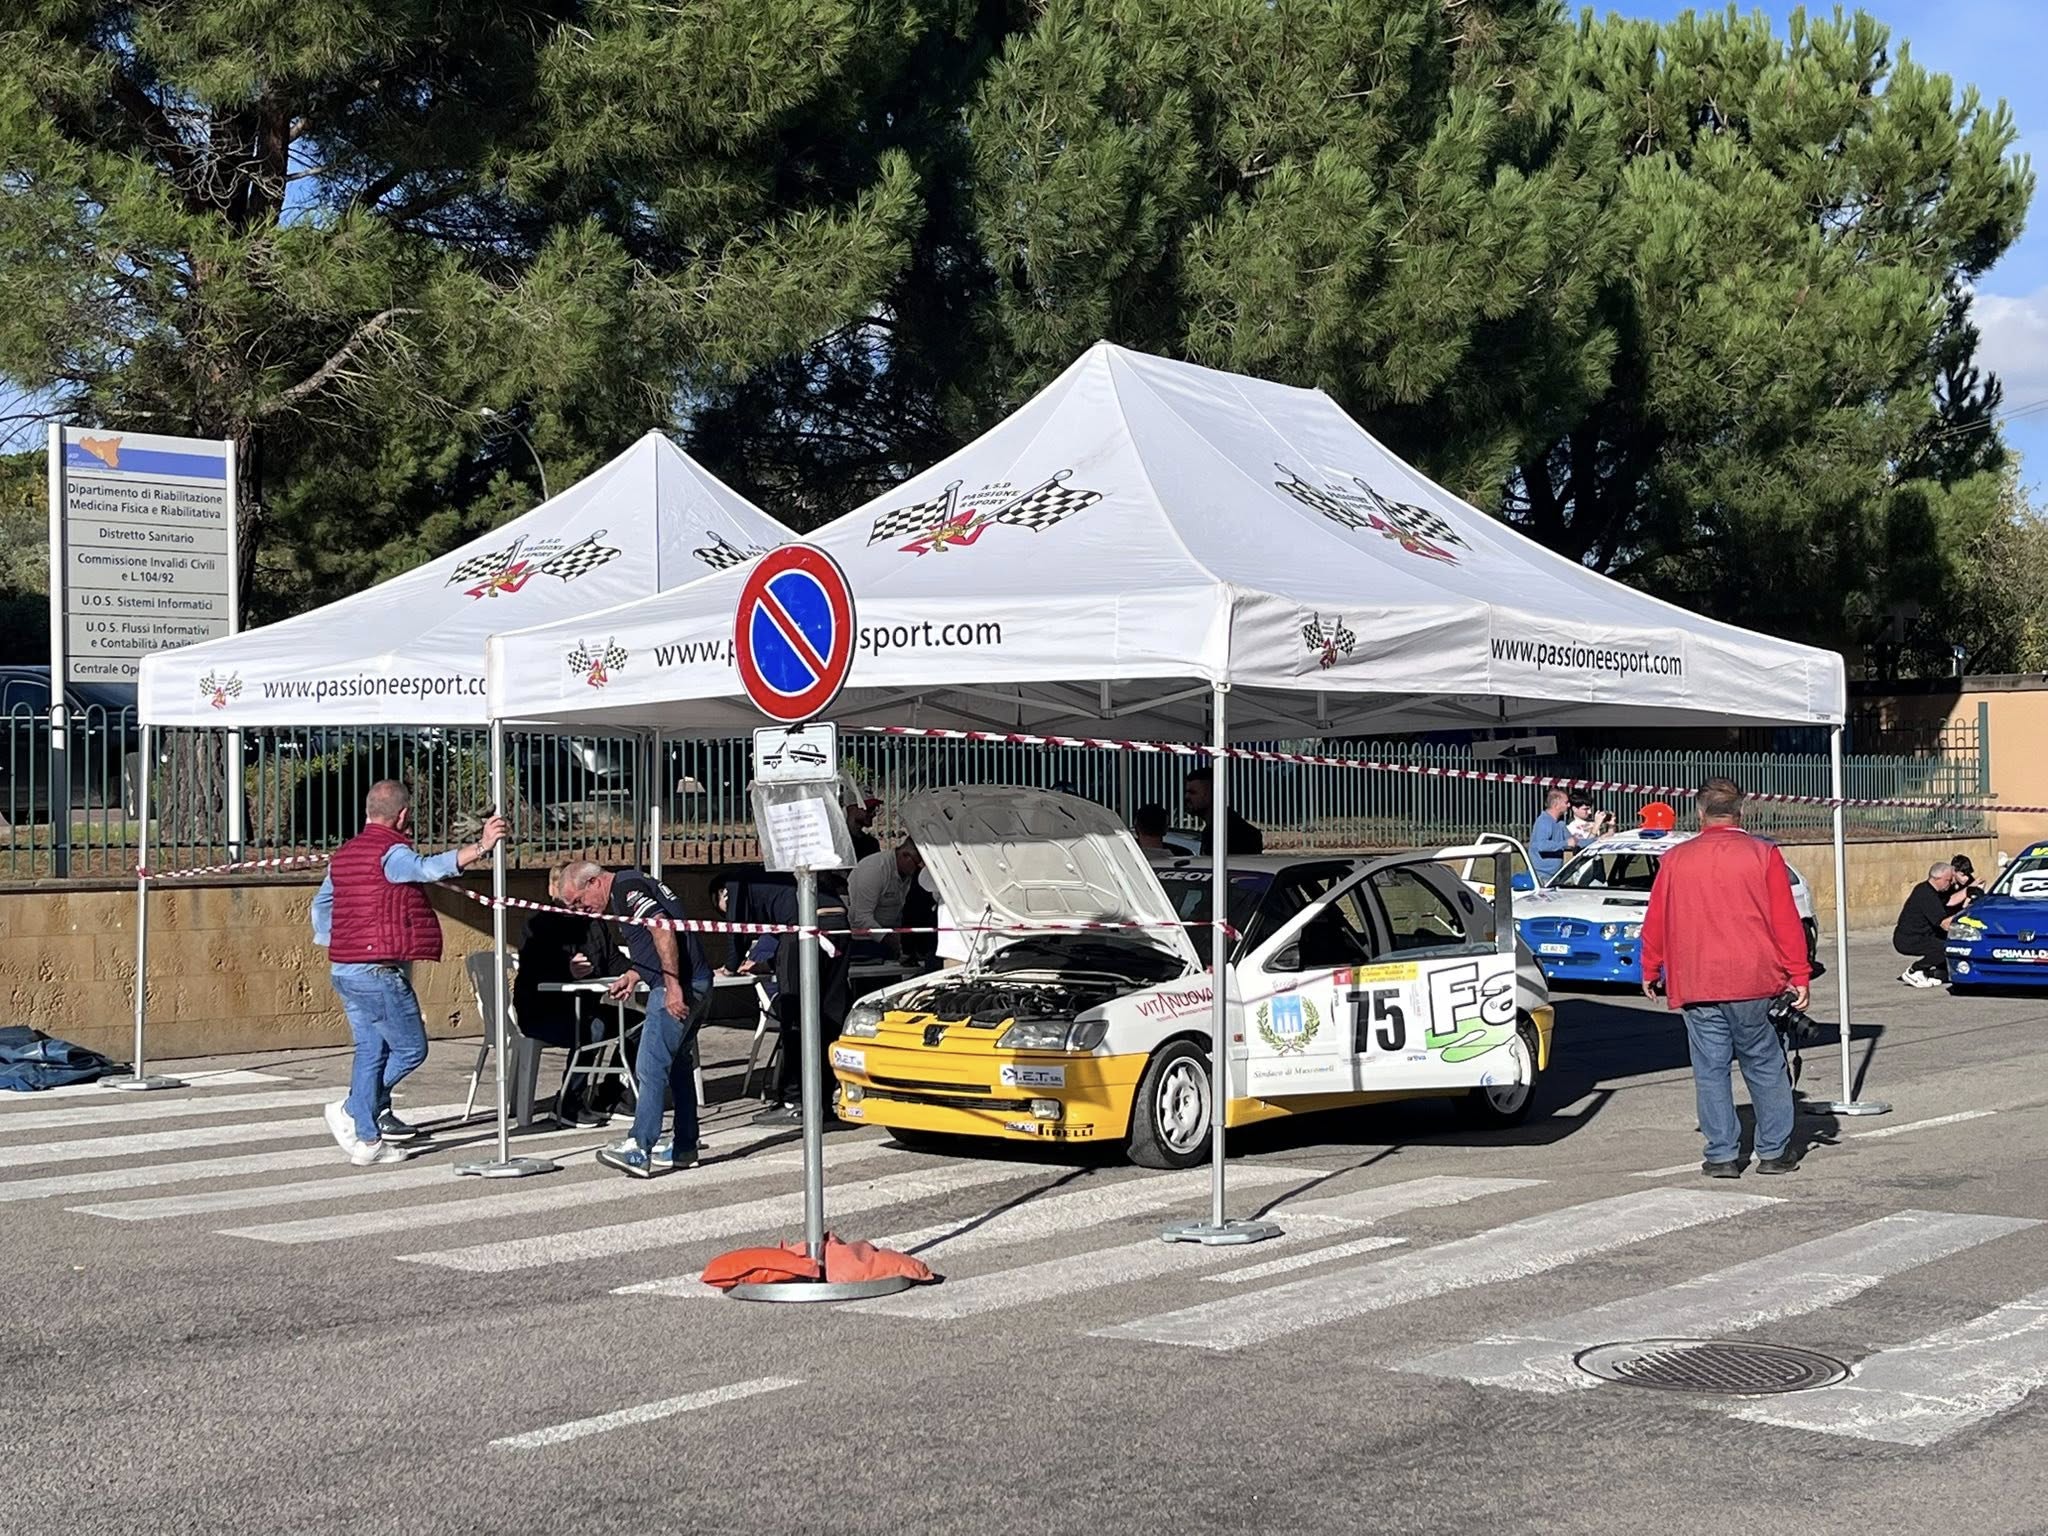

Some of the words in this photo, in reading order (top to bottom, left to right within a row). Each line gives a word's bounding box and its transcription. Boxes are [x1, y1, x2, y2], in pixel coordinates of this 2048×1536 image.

[68, 483, 138, 498] Dipartimento
[141, 490, 150, 499] di
[154, 489, 222, 504] Riabilitazione
[962, 490, 1020, 501] PASSIONE
[70, 499, 118, 512] Medicina
[122, 502, 148, 514] Fisica
[161, 506, 220, 519] Riabilitativa
[99, 528, 146, 541] Distretto
[149, 531, 194, 543] Sanitario
[78, 553, 147, 567] Commissione
[150, 557, 188, 569] Invalidi
[191, 559, 215, 570] Civili
[121, 573, 128, 581] e
[131, 571, 174, 583] L.104/92
[81, 595, 114, 606] U.O.S.
[117, 596, 155, 608] Sistemi
[158, 598, 213, 610] Informatici
[86, 622, 118, 632] U.O.S.
[121, 622, 150, 633] Flussi
[153, 624, 209, 635] Informativi
[91, 640, 97, 648] e
[100, 638, 158, 649] Contabilità
[1491, 638, 1682, 678] www.passioneesport.com
[73, 663, 118, 674] Centrale
[264, 673, 486, 703] www.passioneesport.co
[1346, 988, 1406, 1054] 75
[1038, 1123, 1094, 1137] PIRELLI
